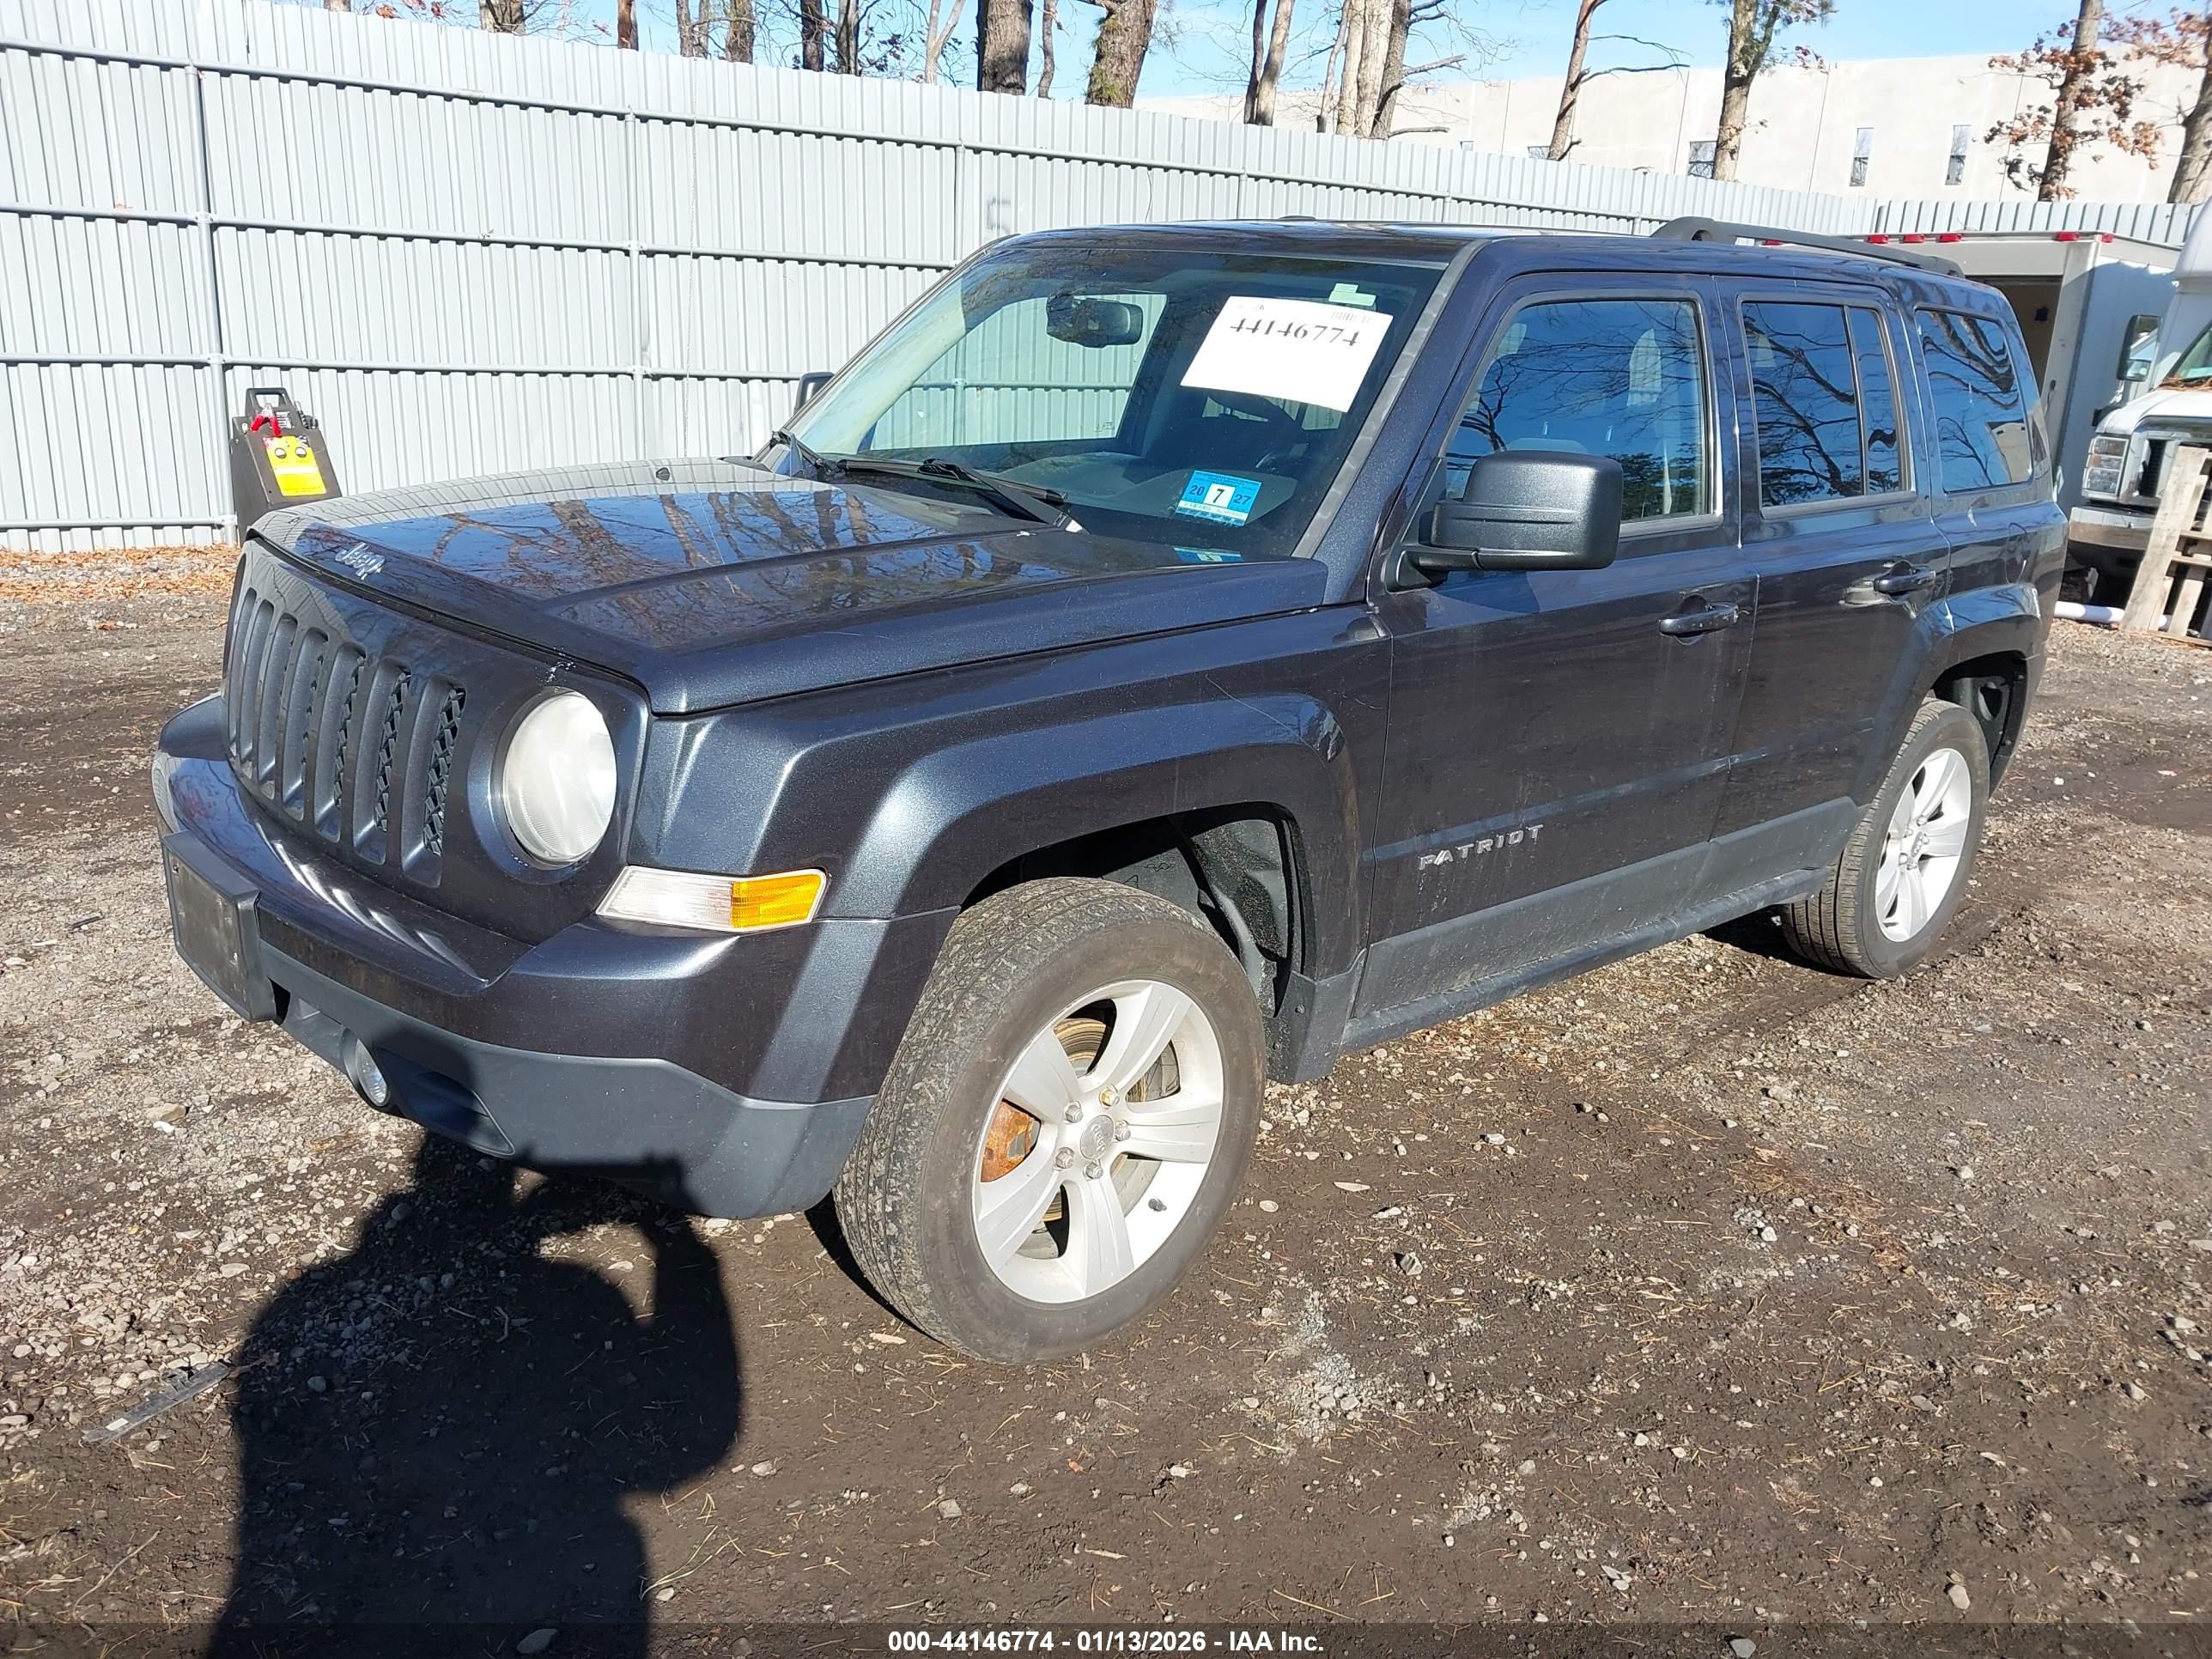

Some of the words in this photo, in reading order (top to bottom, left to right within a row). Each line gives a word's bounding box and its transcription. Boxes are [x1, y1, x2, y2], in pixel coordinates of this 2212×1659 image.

[1230, 318, 1360, 347] 44146774
[1189, 484, 1206, 496] 20
[1213, 488, 1226, 504] 7
[1234, 494, 1252, 505] 27
[335, 542, 386, 580] Jeep
[1417, 823, 1545, 871] PATRIOT
